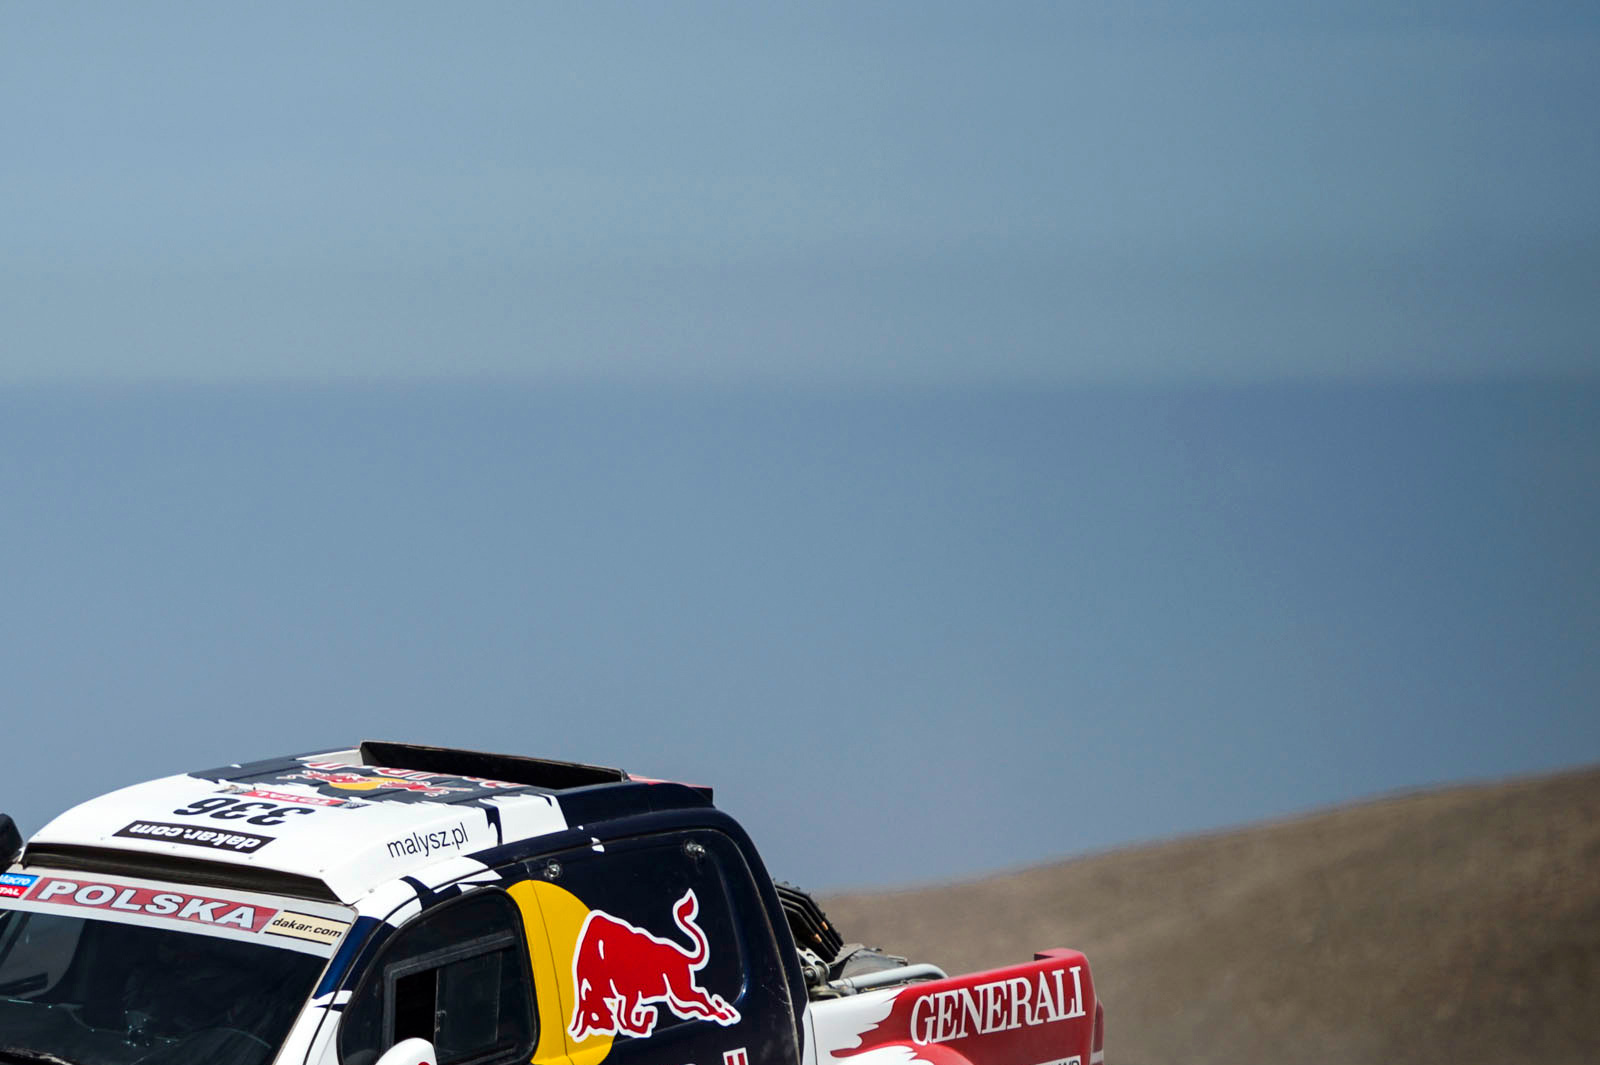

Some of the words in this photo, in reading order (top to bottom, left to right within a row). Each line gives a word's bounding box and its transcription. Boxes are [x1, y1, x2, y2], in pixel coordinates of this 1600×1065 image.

[173, 798, 317, 826] 336
[128, 823, 263, 850] dakar.com
[387, 822, 470, 860] malysz.pl
[36, 880, 257, 930] POLSKA
[272, 916, 343, 940] dakar.com
[910, 966, 1087, 1046] GENERALI
